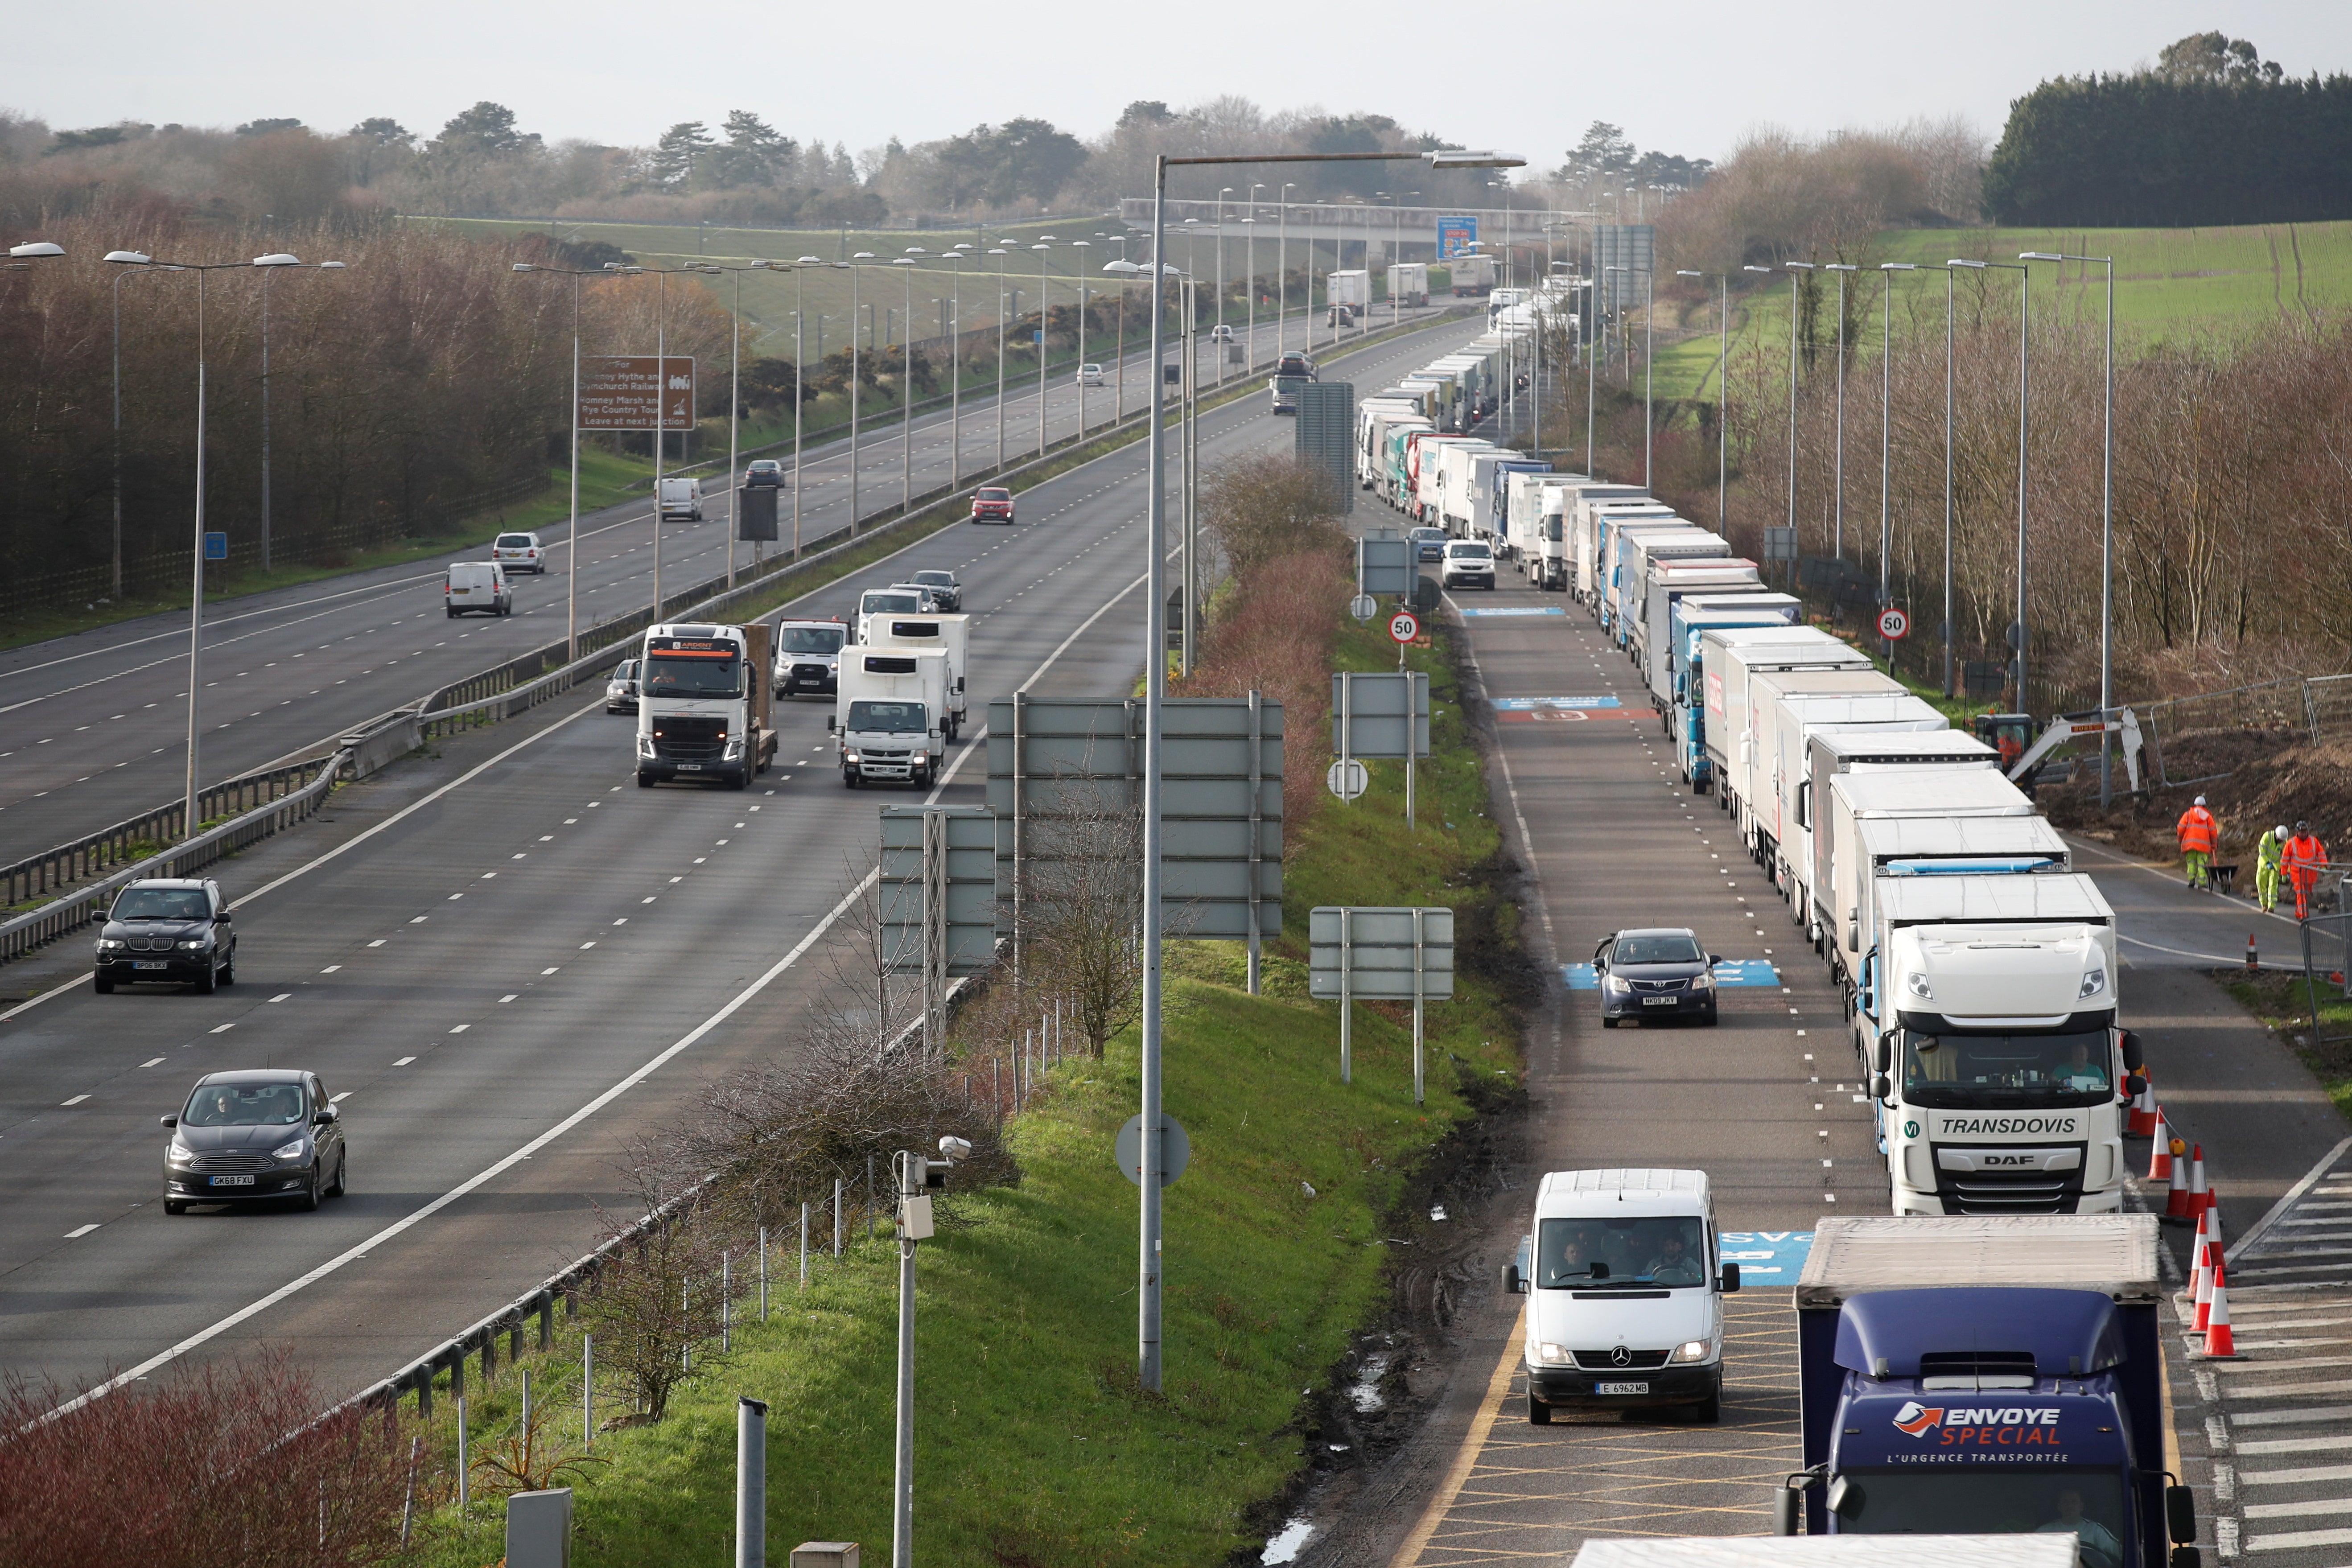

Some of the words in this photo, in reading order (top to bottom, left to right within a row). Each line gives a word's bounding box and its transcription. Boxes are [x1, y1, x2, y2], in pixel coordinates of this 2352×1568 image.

[618, 373, 644, 381] Hythe
[582, 406, 599, 415] Rye
[601, 406, 637, 415] Country
[649, 418, 685, 426] juction
[1395, 621, 1412, 634] 50
[1884, 617, 1902, 630] 50
[1906, 1123, 1917, 1136] VI
[1942, 1118, 2076, 1134] TRANSDOVIS
[1984, 1156, 2034, 1165] DAF
[214, 1177, 235, 1185] GK68
[237, 1176, 253, 1184] FXU
[1604, 1384, 1610, 1393] E
[1945, 1408, 2061, 1425] ENVOYE
[1940, 1427, 2061, 1445] SPECIAL
[1887, 1454, 1964, 1463] L'URGENCE
[1971, 1452, 2068, 1462] TRANSPORTÉE
